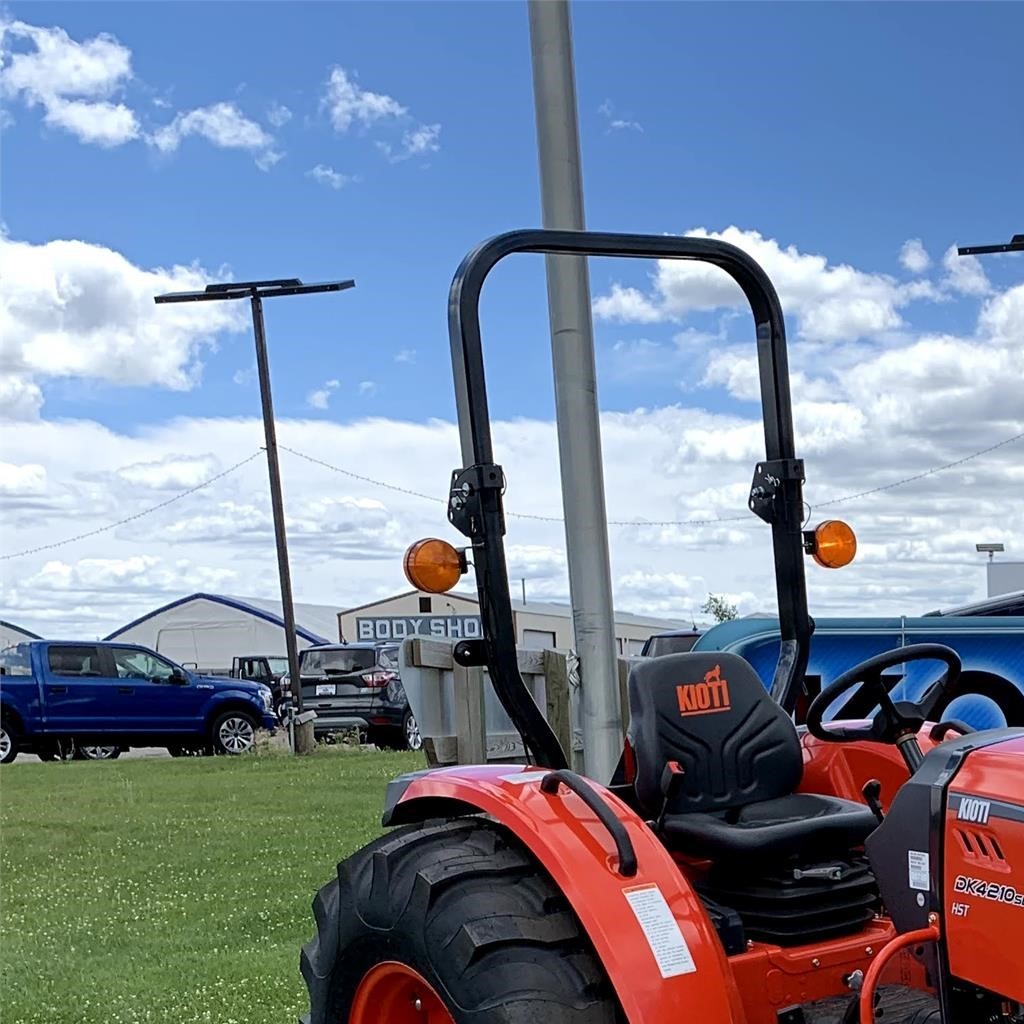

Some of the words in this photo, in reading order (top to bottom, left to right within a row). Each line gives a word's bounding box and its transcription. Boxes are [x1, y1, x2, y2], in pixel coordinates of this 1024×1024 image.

[359, 619, 422, 639] BODY
[429, 618, 483, 638] SHO
[676, 680, 730, 712] KIOTI
[957, 797, 991, 824] KIOTI
[951, 902, 970, 917] HST
